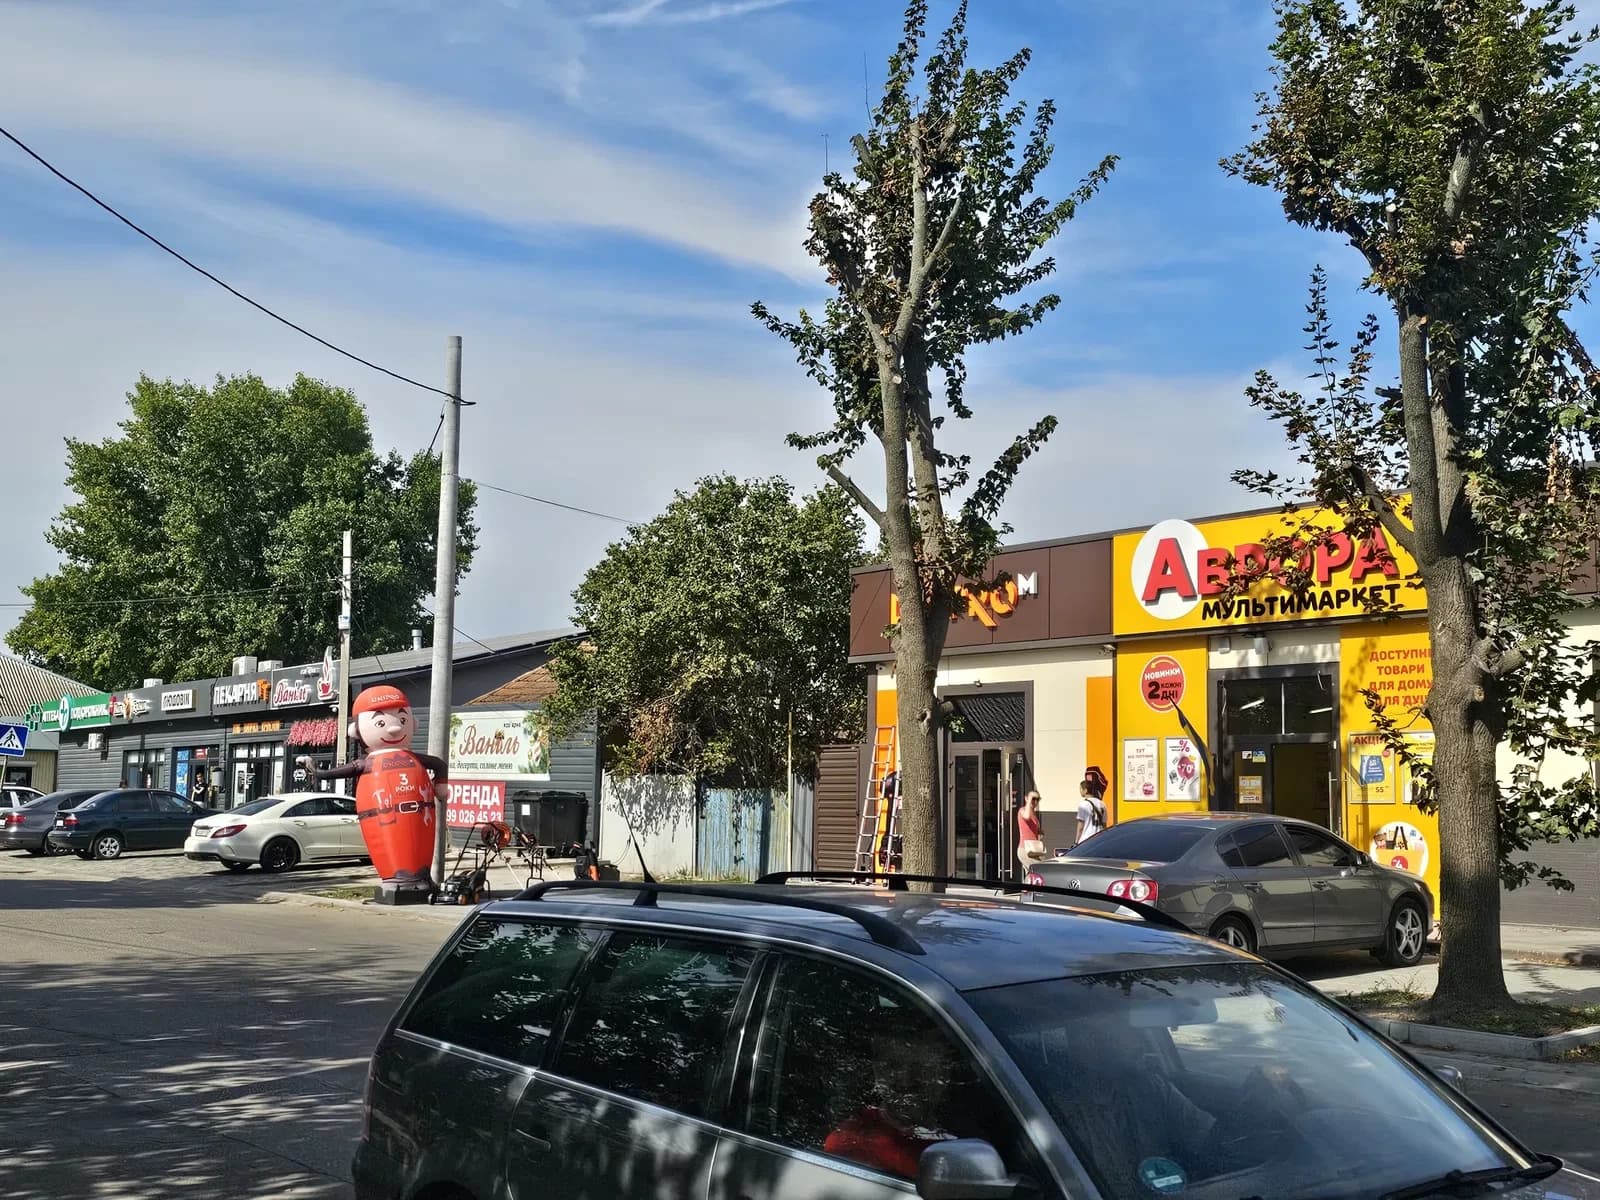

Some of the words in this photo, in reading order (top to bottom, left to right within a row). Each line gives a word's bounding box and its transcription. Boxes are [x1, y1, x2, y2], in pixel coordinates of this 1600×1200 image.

[1202, 583, 1400, 620] МУЛЬТИМАРКЕТ
[1144, 668, 1180, 680] НОВИНКИ
[1377, 664, 1425, 675] ТОВАРИ
[1148, 681, 1161, 699] 2
[1369, 681, 1395, 692] ДЛЯ
[1398, 679, 1434, 691] ДОМУ
[213, 682, 257, 705] ПЕКАРНЯ
[1160, 690, 1178, 701] ДНІ
[460, 724, 520, 755] Ваніль
[399, 773, 408, 785] 3
[447, 784, 500, 809] ОРЕНДА
[459, 809, 474, 823] 026
[477, 811, 488, 823] 45
